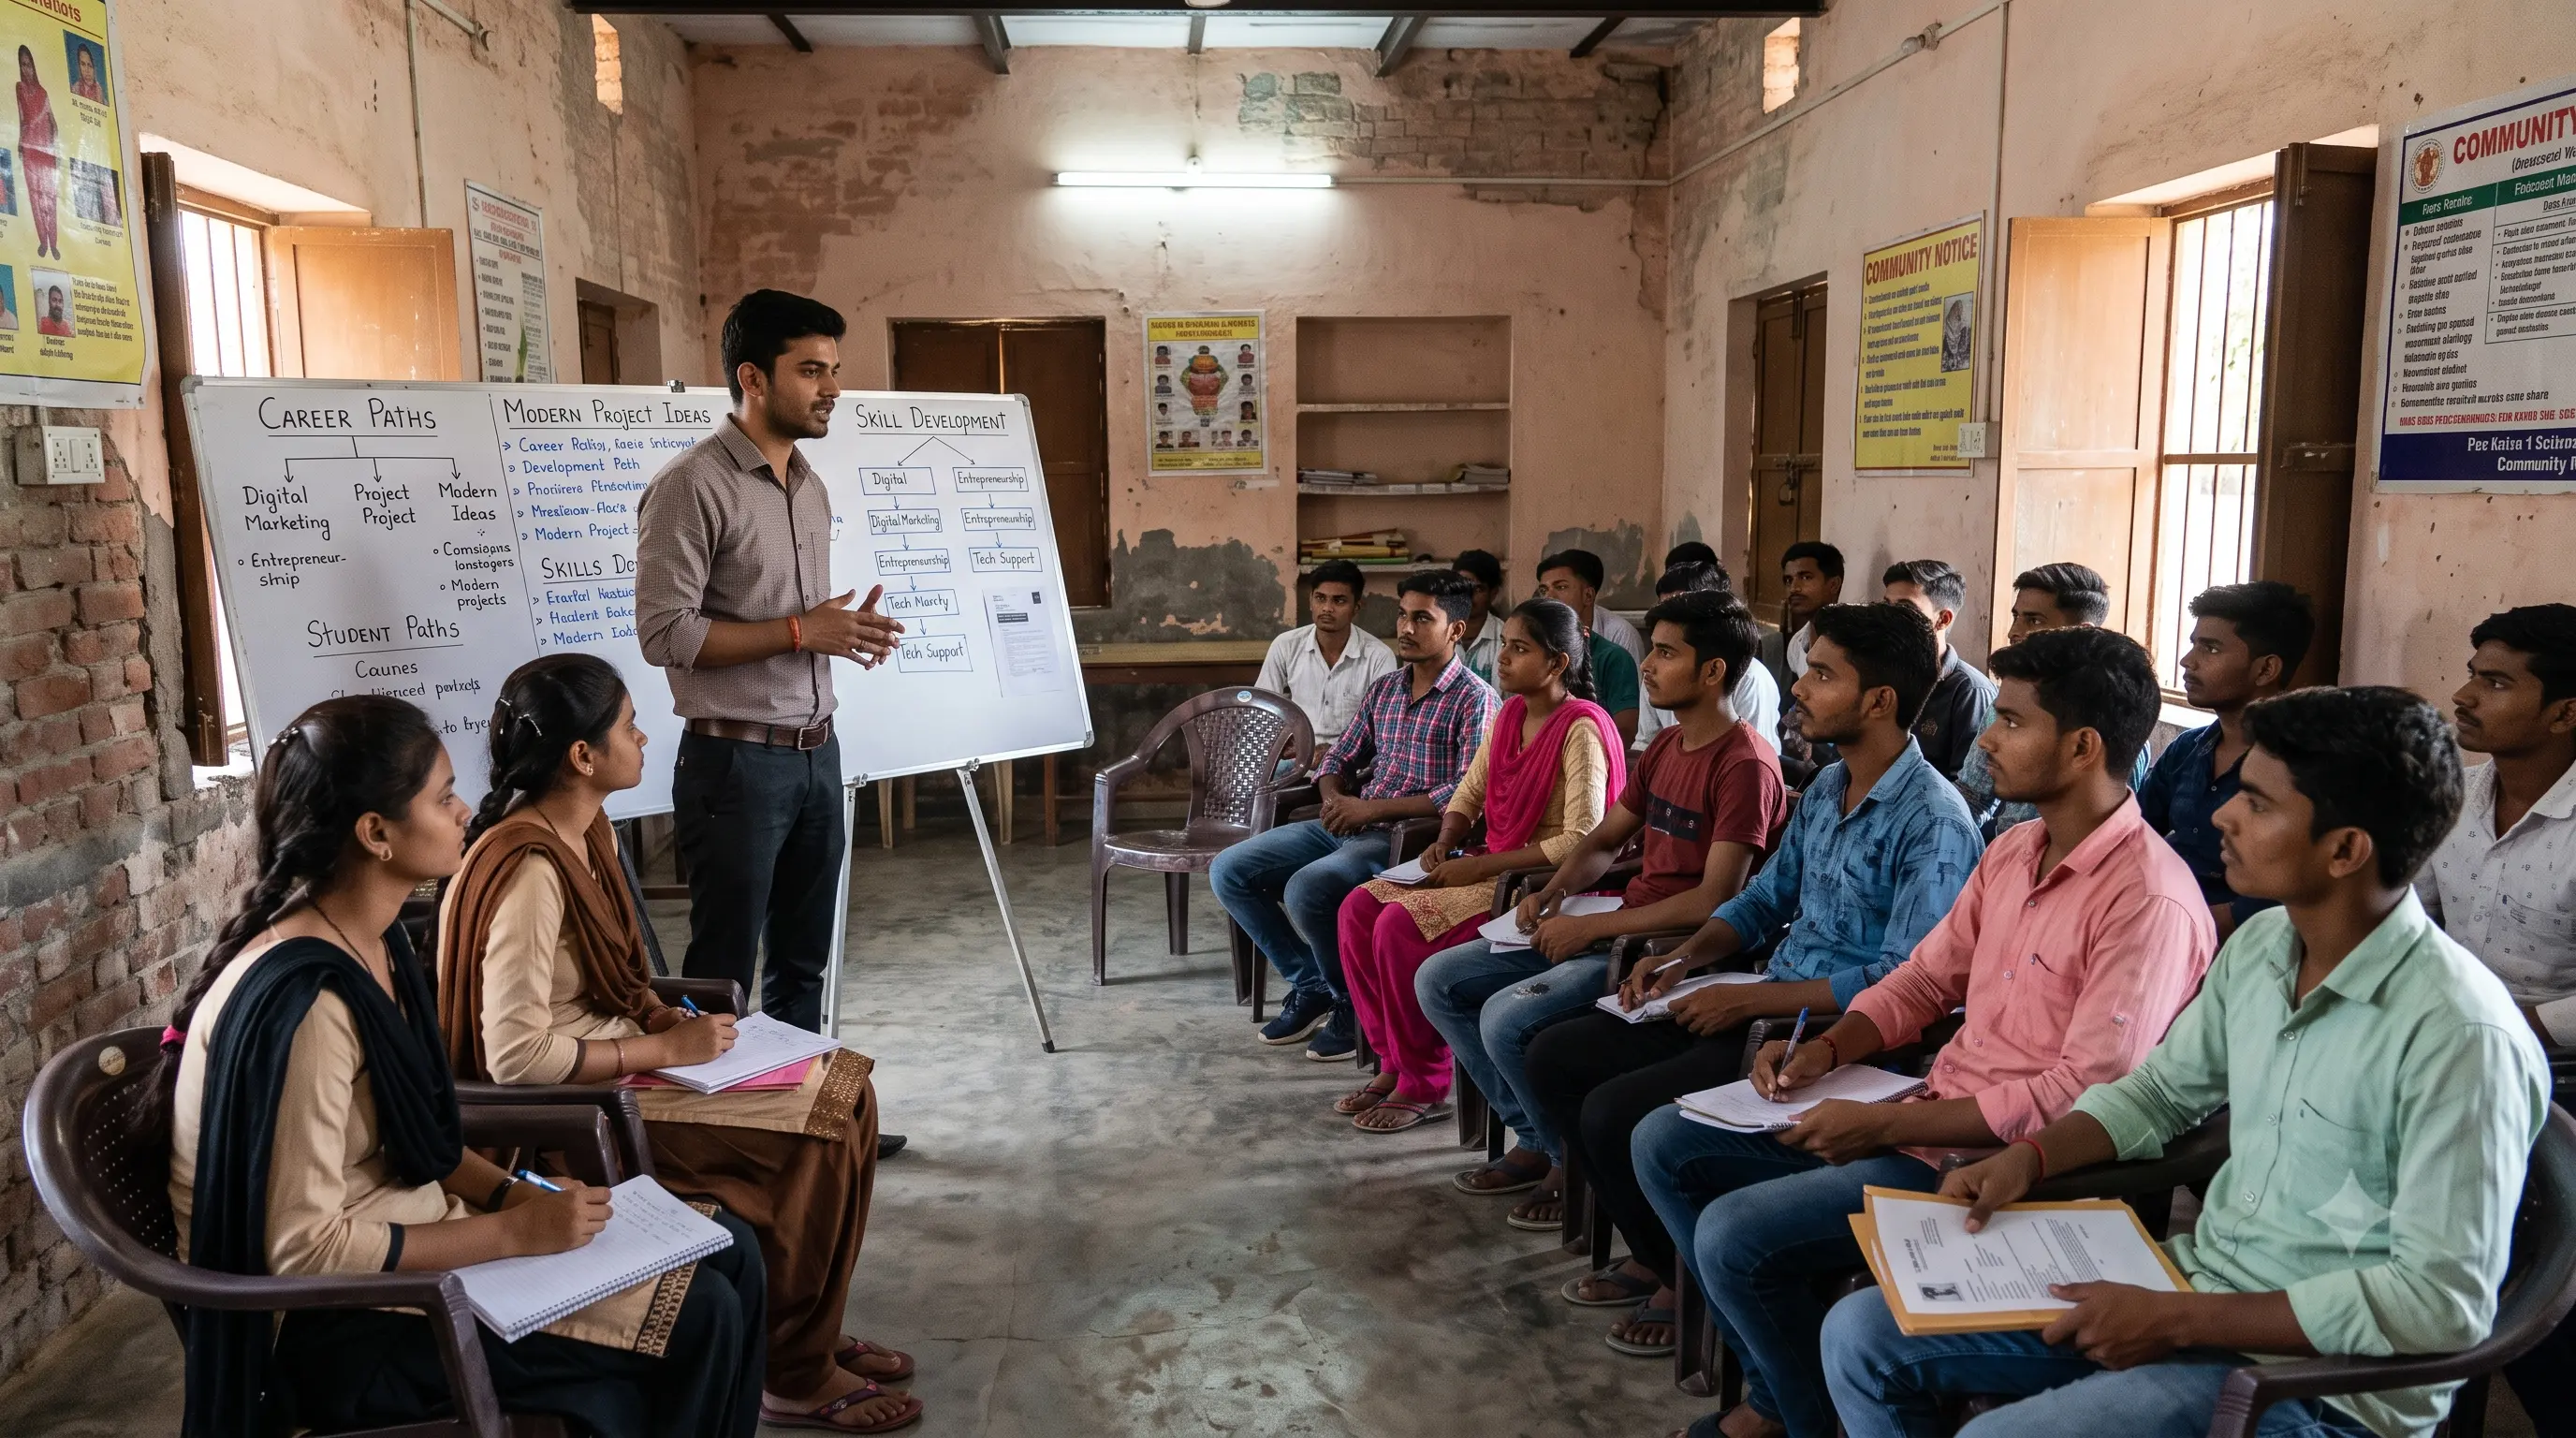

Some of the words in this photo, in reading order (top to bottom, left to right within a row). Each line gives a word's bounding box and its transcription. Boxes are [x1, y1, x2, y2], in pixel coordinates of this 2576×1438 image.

[1866, 246, 1932, 286] COMMUNITY
[1935, 232, 1978, 268] NOTICE
[2526, 390, 2549, 400] share
[258, 397, 353, 429] CAREER
[504, 398, 581, 423] MODERN
[592, 399, 652, 431] PROJECT
[662, 402, 711, 423] IDEAS
[910, 406, 1007, 435] DEVELOPMENT
[519, 437, 564, 452] Career
[522, 458, 606, 477] Development
[2497, 456, 2568, 476] Community
[438, 482, 498, 499] Modern
[872, 472, 907, 492] Digital
[958, 472, 1024, 490] Entrepreneurship
[242, 485, 308, 513] Digital
[354, 483, 410, 507] Project
[363, 507, 416, 531] Project
[452, 505, 497, 521] Ideas
[245, 515, 330, 540] Marketing
[535, 526, 583, 541] Modern
[589, 523, 630, 540] Project
[871, 514, 901, 534] Digital
[251, 552, 346, 571] Entrepreneur-
[973, 551, 996, 565] Tech
[541, 557, 602, 580] SKILLS
[451, 580, 500, 592] Modern
[457, 594, 506, 610] projects
[887, 595, 912, 609] Tech
[406, 615, 460, 640] Paths
[900, 643, 923, 659] Tech
[926, 642, 964, 662] Support
[445, 720, 458, 734] to
